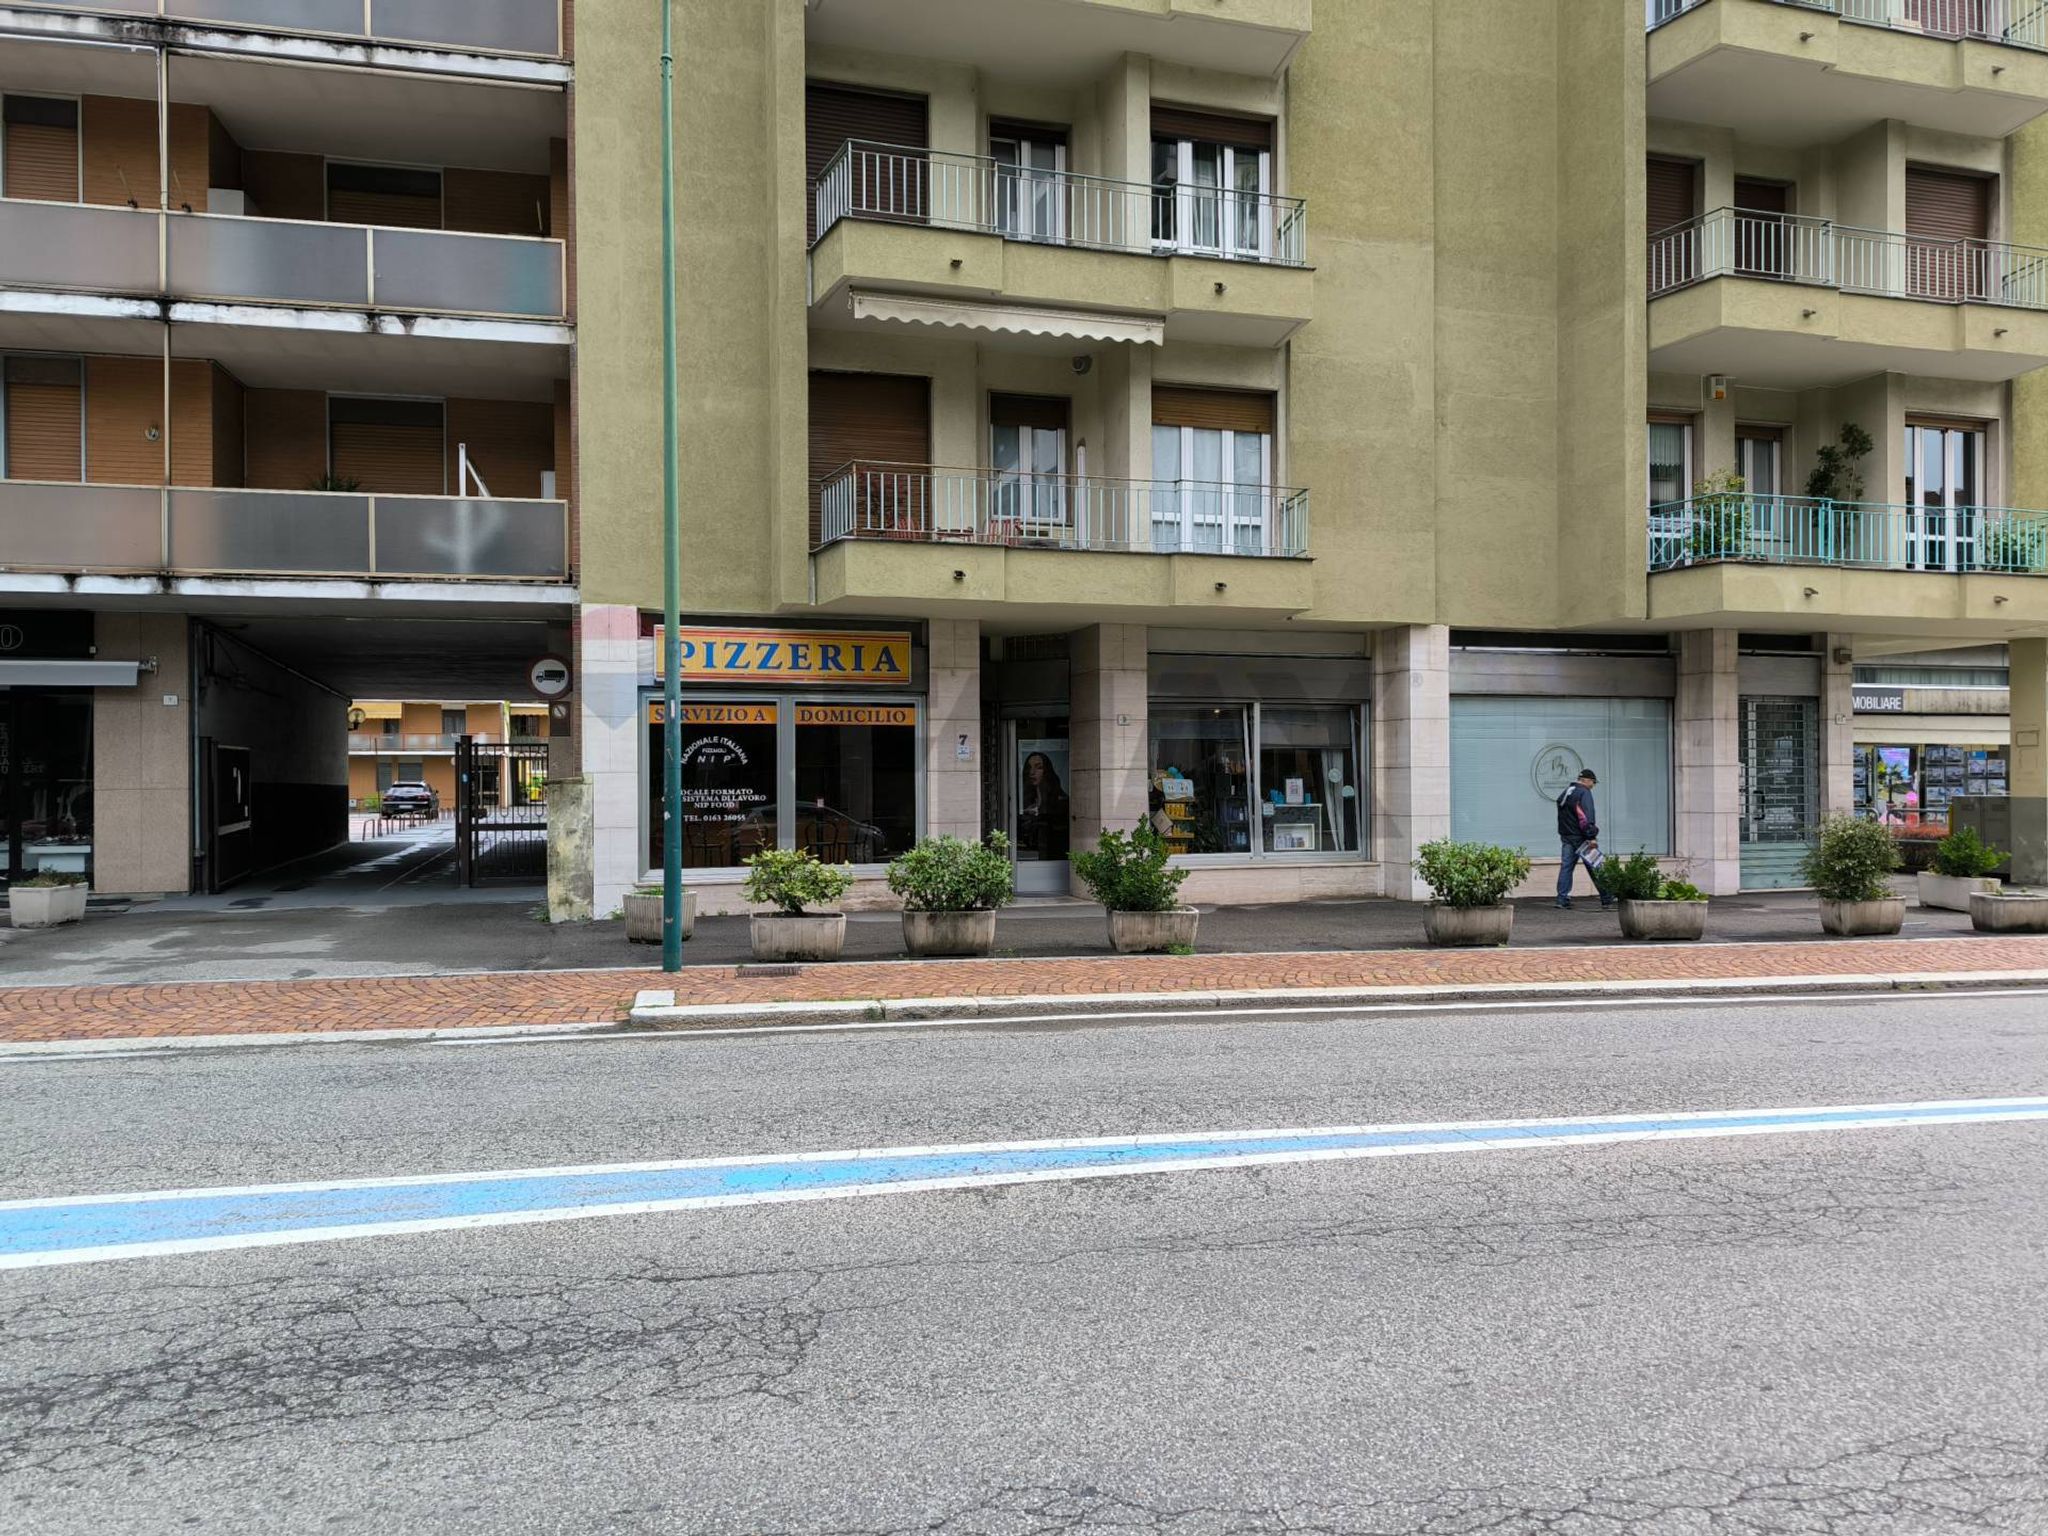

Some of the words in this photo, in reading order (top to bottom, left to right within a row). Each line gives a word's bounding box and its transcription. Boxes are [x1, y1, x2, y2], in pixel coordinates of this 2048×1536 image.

[680, 640, 901, 672] PIZZERIA
[654, 708, 748, 721] SRVIZIO
[754, 709, 766, 721] A
[800, 709, 906, 722] DOMICILIO
[680, 736, 719, 765] NAZIONALE
[719, 737, 749, 765] ITALIANA
[958, 734, 968, 746] 7
